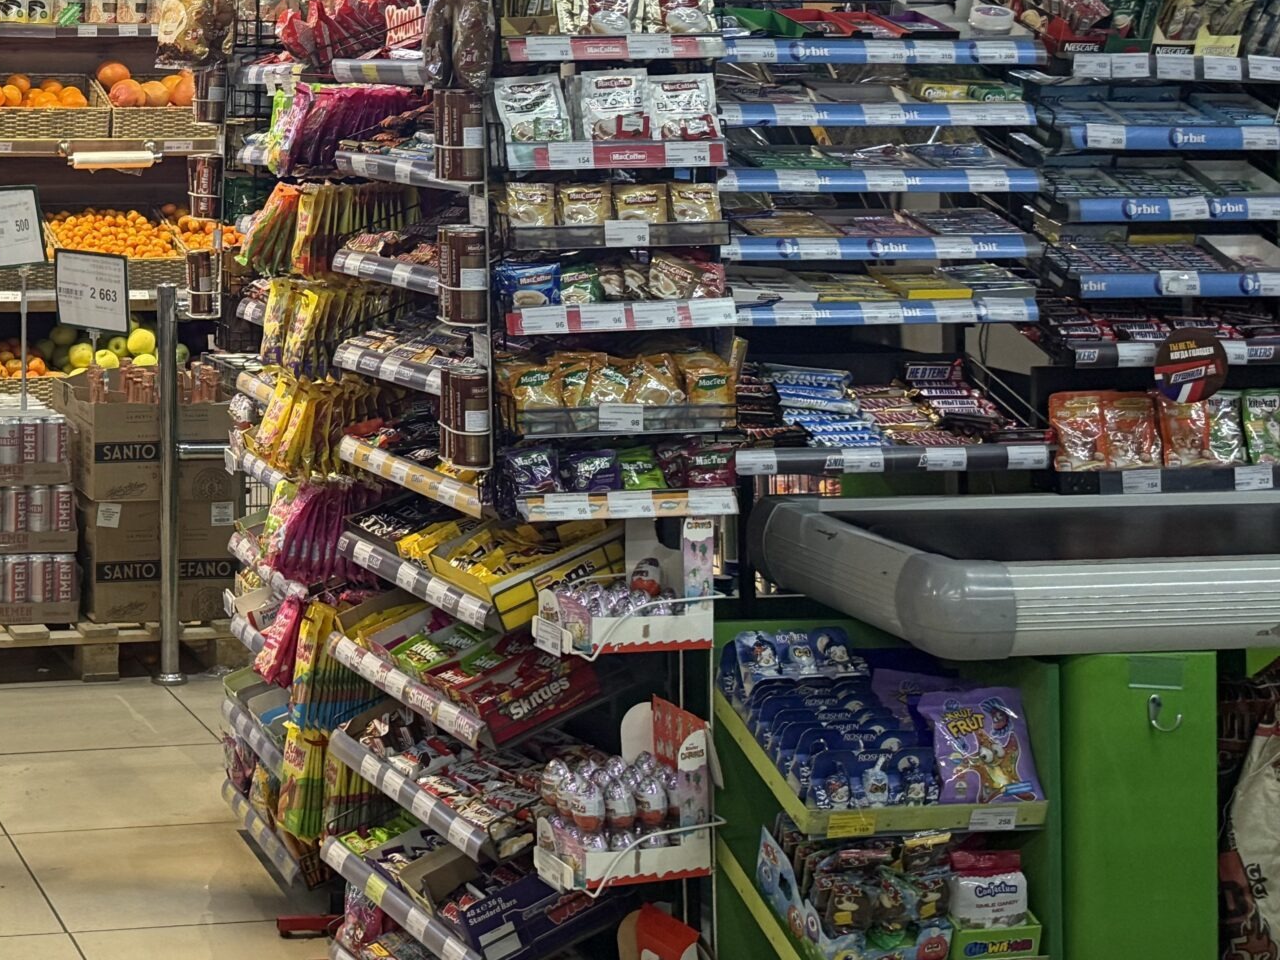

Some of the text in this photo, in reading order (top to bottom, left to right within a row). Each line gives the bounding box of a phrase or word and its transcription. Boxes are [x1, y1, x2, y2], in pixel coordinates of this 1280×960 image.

[612, 153, 645, 161] MacCoffee
[201, 167, 210, 213] MaCoffee
[15, 219, 30, 233] 500
[520, 274, 552, 284] MacCoffee
[90, 287, 96, 299] 2
[99, 288, 117, 302] 663
[521, 371, 550, 383] MacTea
[909, 367, 921, 379] НЕ
[928, 366, 949, 378] ТЕМЕ
[698, 377, 726, 387] MacTea
[103, 444, 156, 460] SANTO
[695, 455, 727, 465] MacTea
[104, 561, 231, 579] SANTO EFANO
[509, 675, 570, 720] Skittles
[804, 697, 838, 706] ROSHEN
[818, 712, 851, 720] ROSHEN
[948, 715, 985, 738] FRUT
[844, 732, 877, 741] ROSHEN
[858, 752, 893, 762] ROSHEN
[975, 881, 1018, 898] Confectum
[468, 903, 501, 925] Standard
